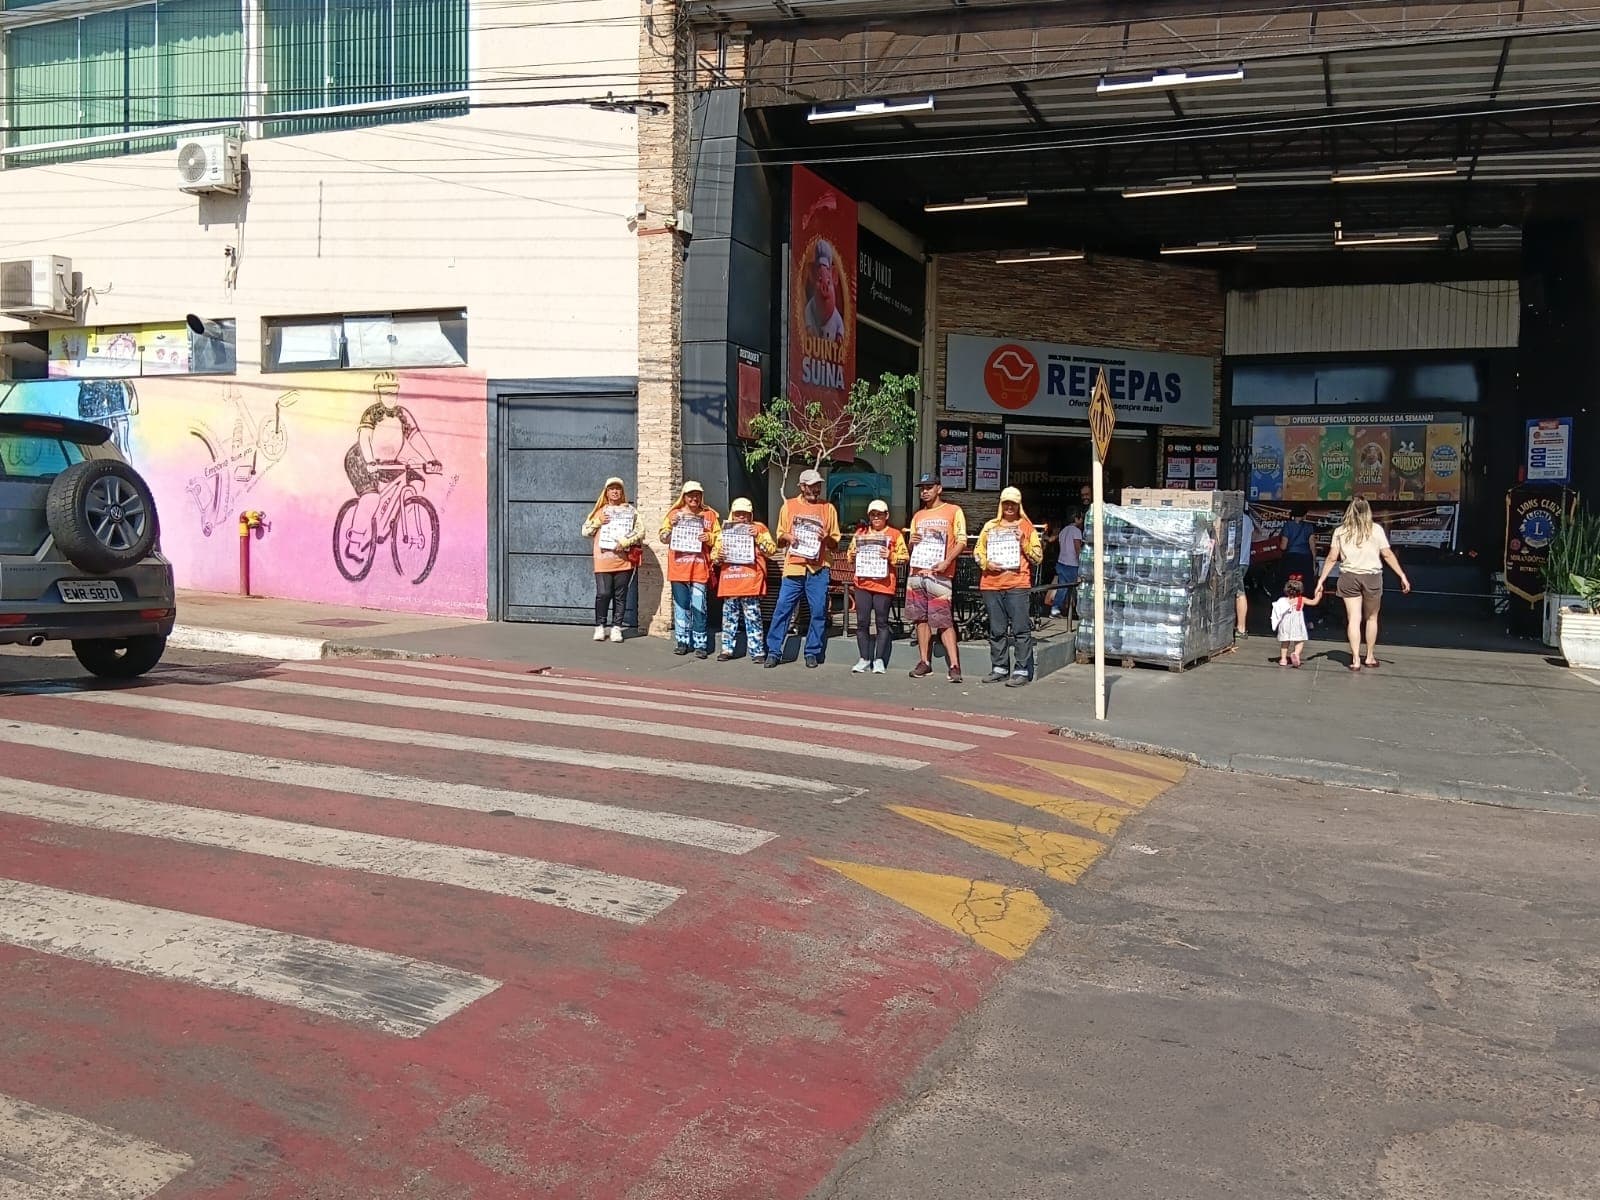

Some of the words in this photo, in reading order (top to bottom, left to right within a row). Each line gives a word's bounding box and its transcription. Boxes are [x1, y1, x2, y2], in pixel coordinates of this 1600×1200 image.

[804, 336, 845, 364] QUINTA
[1292, 416, 1318, 424] OFERTAS
[1348, 415, 1369, 423] TODOS
[1369, 415, 1379, 423] OS
[1379, 414, 1394, 422] DIAS
[1394, 414, 1405, 422] DA
[1517, 499, 1539, 515] LIONS
[1534, 522, 1544, 536] L
